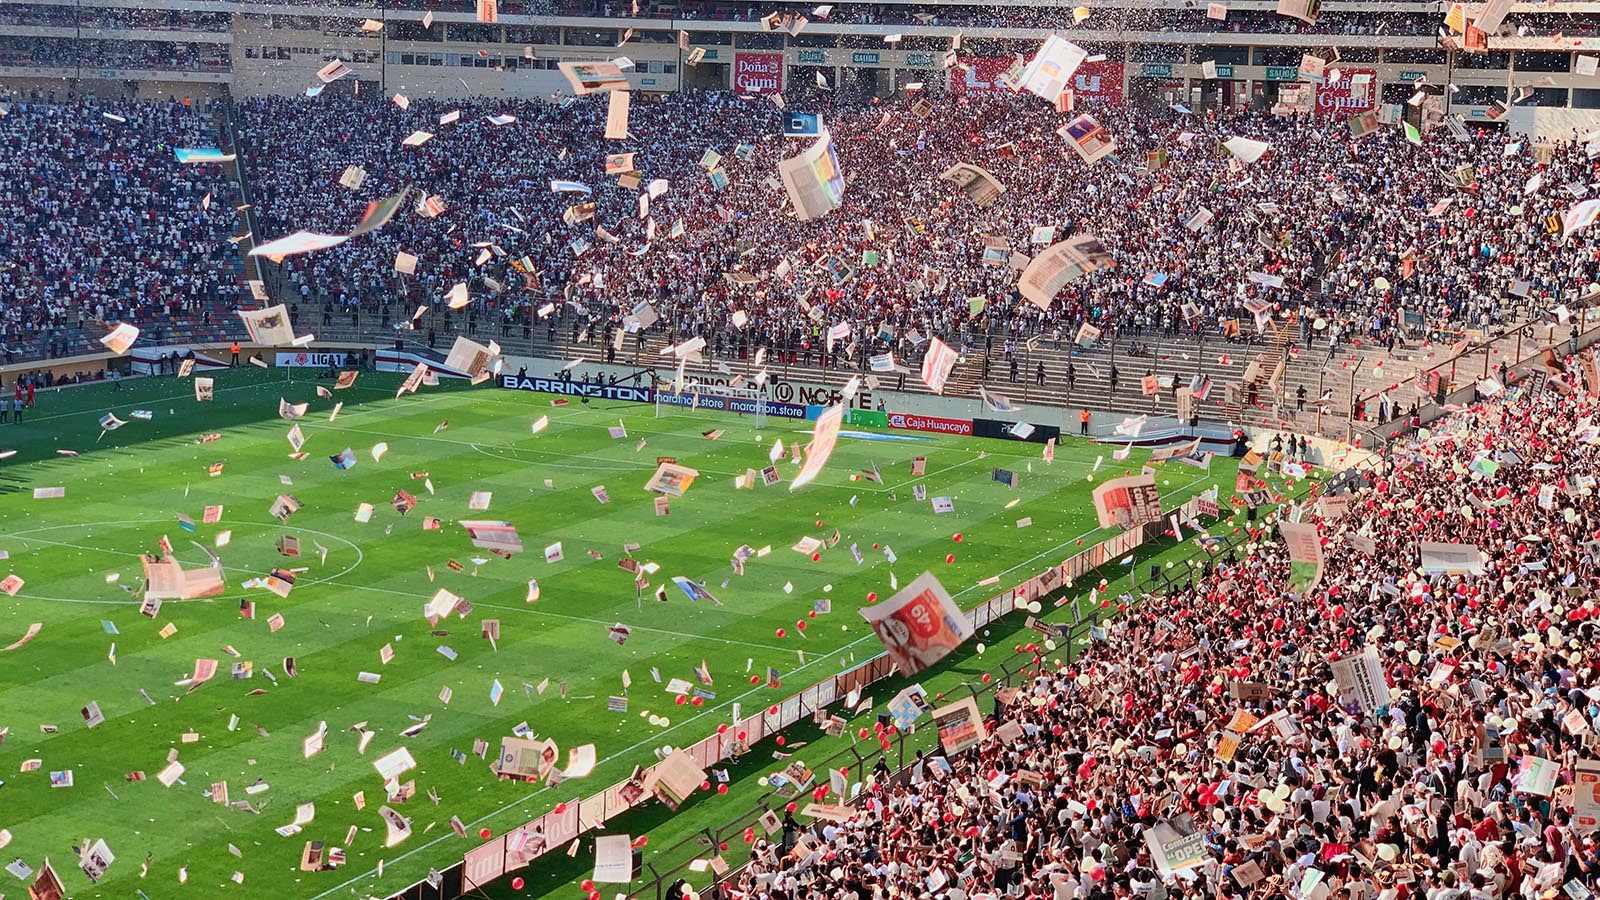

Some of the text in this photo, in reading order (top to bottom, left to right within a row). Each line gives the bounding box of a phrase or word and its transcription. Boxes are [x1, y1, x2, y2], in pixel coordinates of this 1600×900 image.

[740, 59, 768, 73] Doña
[1216, 67, 1231, 75] LIDA
[737, 74, 777, 89] Gumi
[503, 375, 649, 402] BARRINGTON
[653, 392, 724, 409] maratho.store
[799, 386, 872, 410] NORTE
[906, 416, 970, 433] Caja Huancayo
